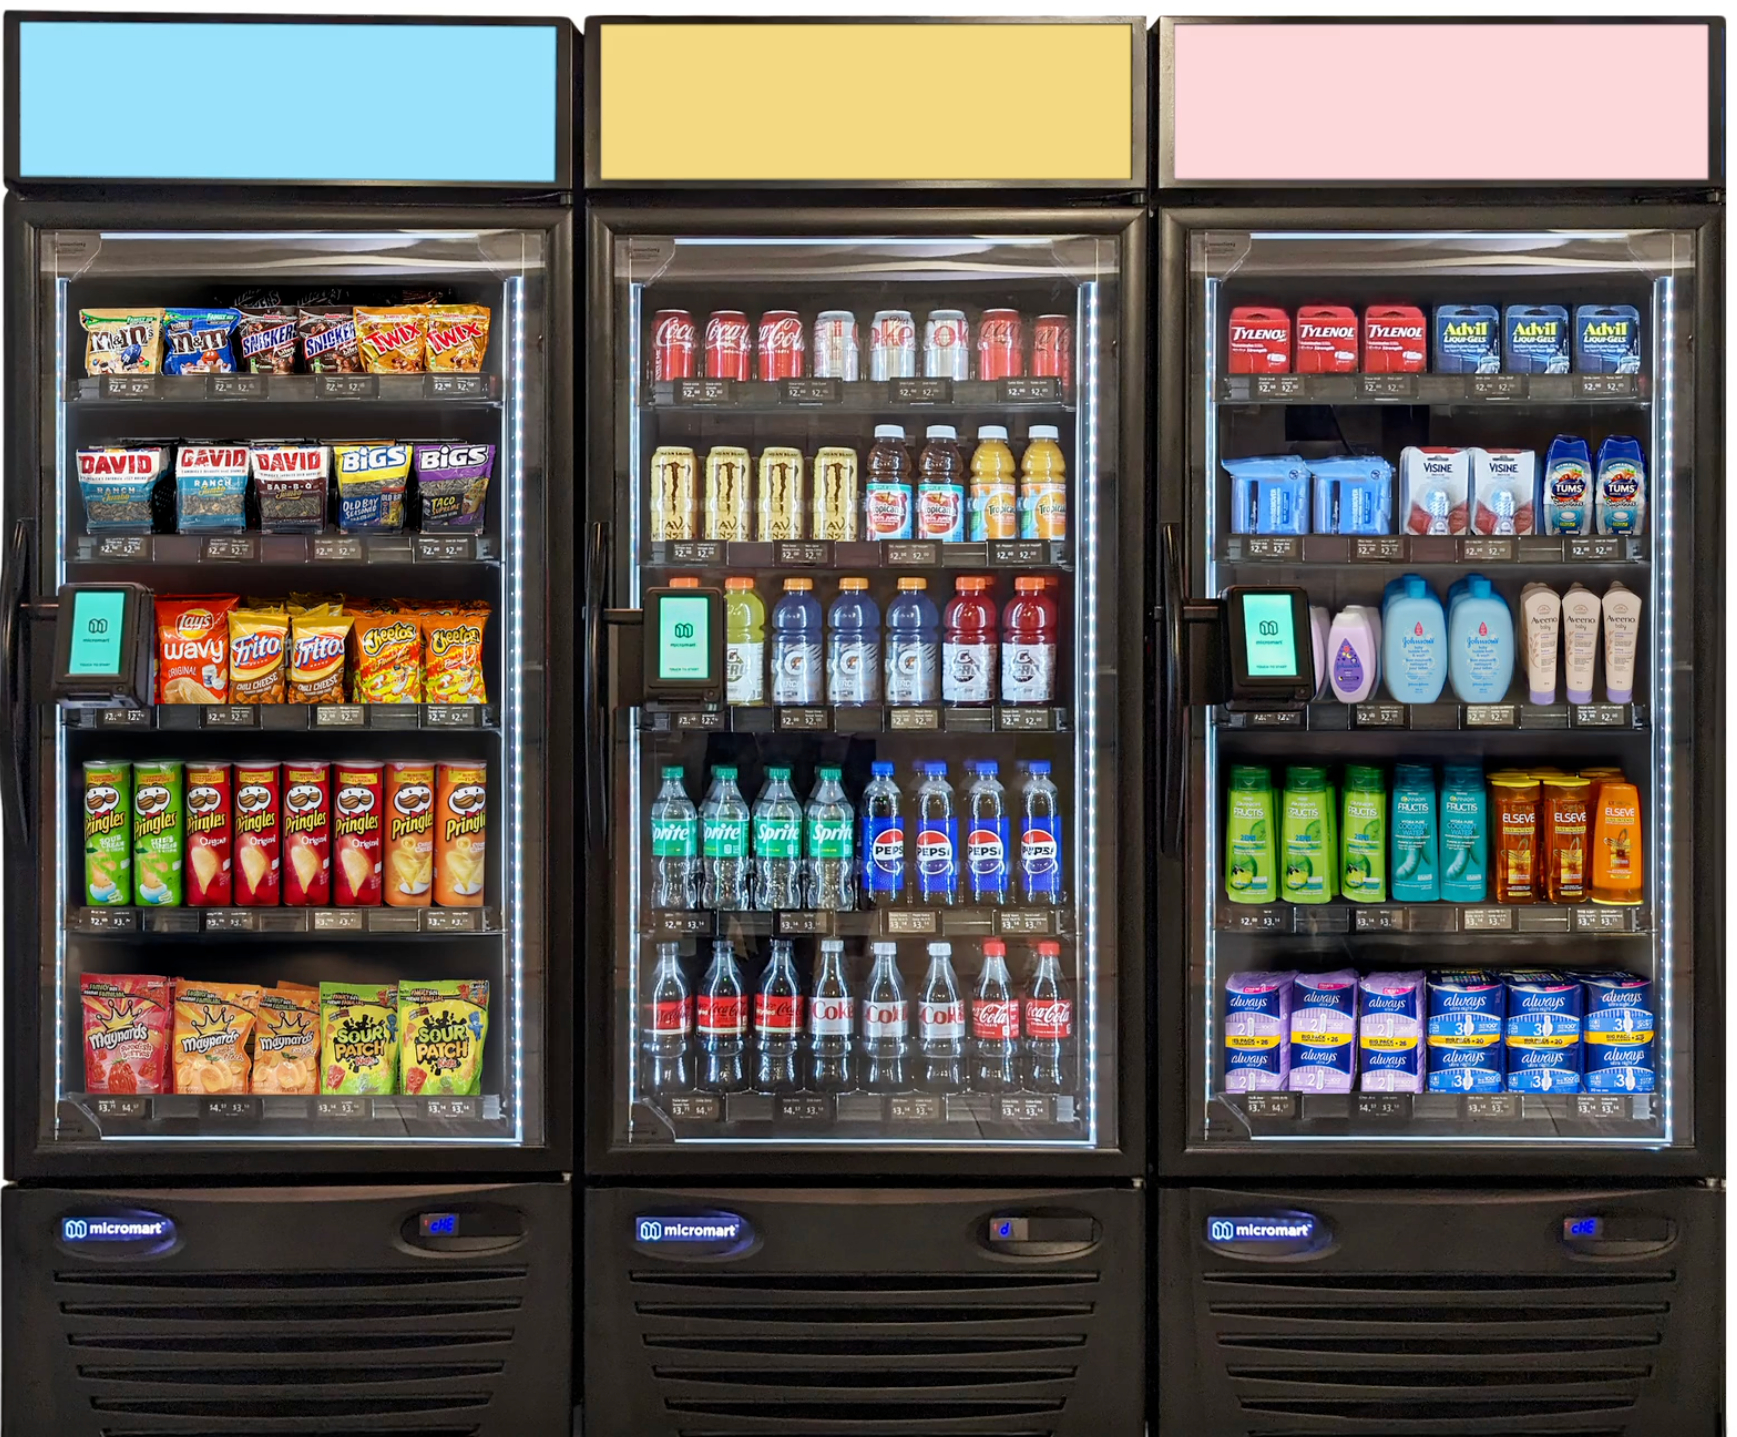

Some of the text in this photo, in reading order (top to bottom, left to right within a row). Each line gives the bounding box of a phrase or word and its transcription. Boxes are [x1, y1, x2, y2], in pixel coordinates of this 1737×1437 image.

[656, 317, 694, 347] Coca
[1300, 324, 1355, 339] TYLENOL
[1368, 324, 1423, 339] TYLENOL
[1443, 322, 1488, 336] Advil
[1513, 322, 1558, 336] Advil
[1583, 322, 1628, 336] Advil
[365, 321, 421, 355] TWIX
[428, 321, 484, 354] TWIX
[78, 454, 152, 474] DAVID
[181, 448, 247, 468] DAVID
[256, 451, 321, 471] DAVID
[1423, 463, 1454, 473] VISINE
[1489, 463, 1519, 473] VISINE
[194, 479, 232, 487] RANCH
[266, 483, 313, 491] BAR-B-Q
[1555, 483, 1583, 493] TUMS
[1607, 483, 1635, 493] TUMS
[342, 497, 379, 513] OLD BAY
[431, 496, 456, 508] TACO
[345, 505, 377, 519] SEASONED
[1531, 616, 1558, 624] Aveeno
[1566, 616, 1596, 624] Aveeno
[1606, 615, 1636, 623] Aveeno
[1615, 623, 1626, 631] baby
[364, 622, 416, 655] Cheetos
[431, 624, 481, 655] Cheetos
[164, 638, 224, 663] wavy
[168, 666, 197, 679] ORIGINAL
[236, 673, 279, 691] CHILI CHEESE
[313, 675, 338, 691] CHEESE
[1233, 808, 1264, 817] FRUCTIS
[1398, 803, 1429, 812] FRUCTIS
[1446, 803, 1478, 812] FRUCTIS
[1605, 808, 1634, 817] ELSEVE
[135, 811, 177, 837] Pringles
[236, 811, 275, 834] Pringles
[285, 810, 326, 836] Pringles
[1503, 813, 1535, 823] ELSEVE
[1554, 812, 1586, 823] ELSEVE
[335, 813, 379, 839] Pringles
[758, 823, 799, 844] Sprite
[1304, 991, 1341, 1007] always
[1369, 995, 1406, 1011] always
[1443, 994, 1487, 1011] always
[1522, 995, 1566, 1012] always
[1602, 990, 1642, 1008] always
[812, 1000, 854, 1021] Coke
[1026, 1002, 1070, 1024] Coca-Cola
[1455, 1022, 1463, 1035] 3
[1533, 1023, 1542, 1035] 3
[1615, 1019, 1624, 1032] 3
[88, 1024, 149, 1050] Maynards
[182, 1030, 240, 1053] Maynards
[259, 1031, 315, 1052] Maynards
[337, 1026, 384, 1044] SOUR
[418, 1025, 466, 1043] SOUR
[334, 1040, 386, 1059] PATCH
[416, 1040, 469, 1059] PATCH
[1301, 1047, 1337, 1064] always
[1604, 1047, 1644, 1066] always
[1369, 1052, 1407, 1067] always
[1443, 1051, 1485, 1067] always
[1521, 1051, 1564, 1067] always
[1454, 1077, 1463, 1087] 3
[1533, 1077, 1541, 1088] 3
[1616, 1076, 1625, 1087] 3
[90, 1221, 162, 1236] micromart
[664, 1223, 737, 1238] micromart
[1236, 1223, 1309, 1237] micromart
